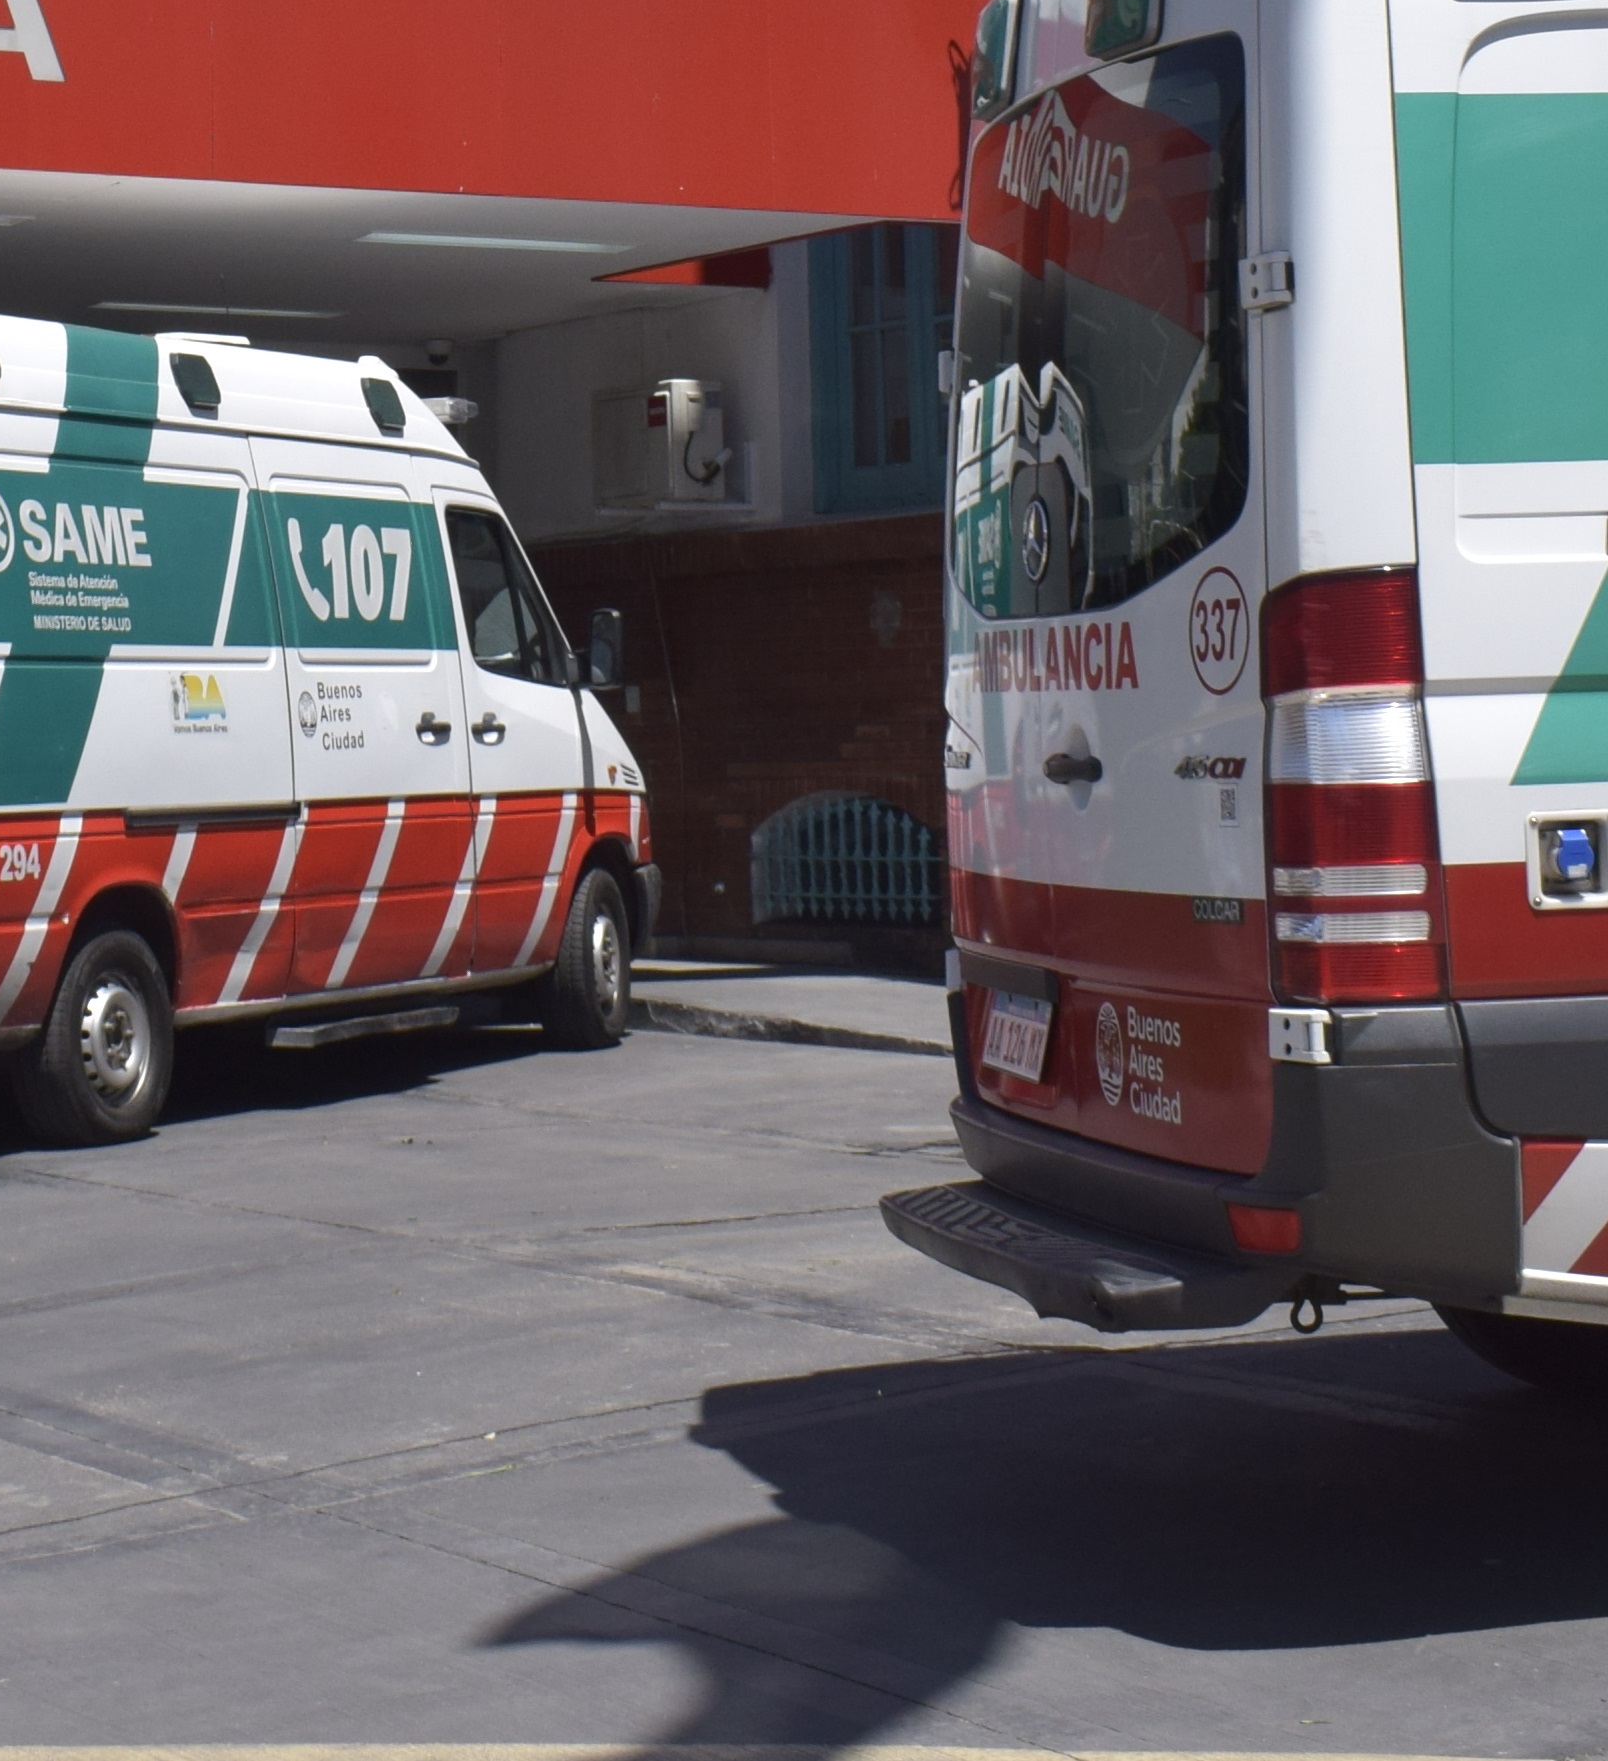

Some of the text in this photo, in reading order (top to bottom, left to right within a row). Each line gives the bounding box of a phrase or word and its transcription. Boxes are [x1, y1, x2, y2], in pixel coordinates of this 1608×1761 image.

[19, 499, 153, 567] SAME
[28, 571, 119, 590] Sistema de Atención
[322, 523, 412, 621] 107
[31, 590, 129, 610] Médica de Emergencia
[34, 615, 132, 632] MINISTERIO DE SALUD
[1195, 598, 1241, 662] 337
[972, 621, 1140, 693] AMBULANCIA
[317, 682, 362, 700] Buenos
[320, 704, 351, 722] Aires
[322, 730, 365, 750] Ciudad
[0, 843, 41, 882] 294
[1126, 1005, 1182, 1048] Buenos
[1128, 1044, 1164, 1083] Aires
[1130, 1081, 1182, 1126] Ciudad
